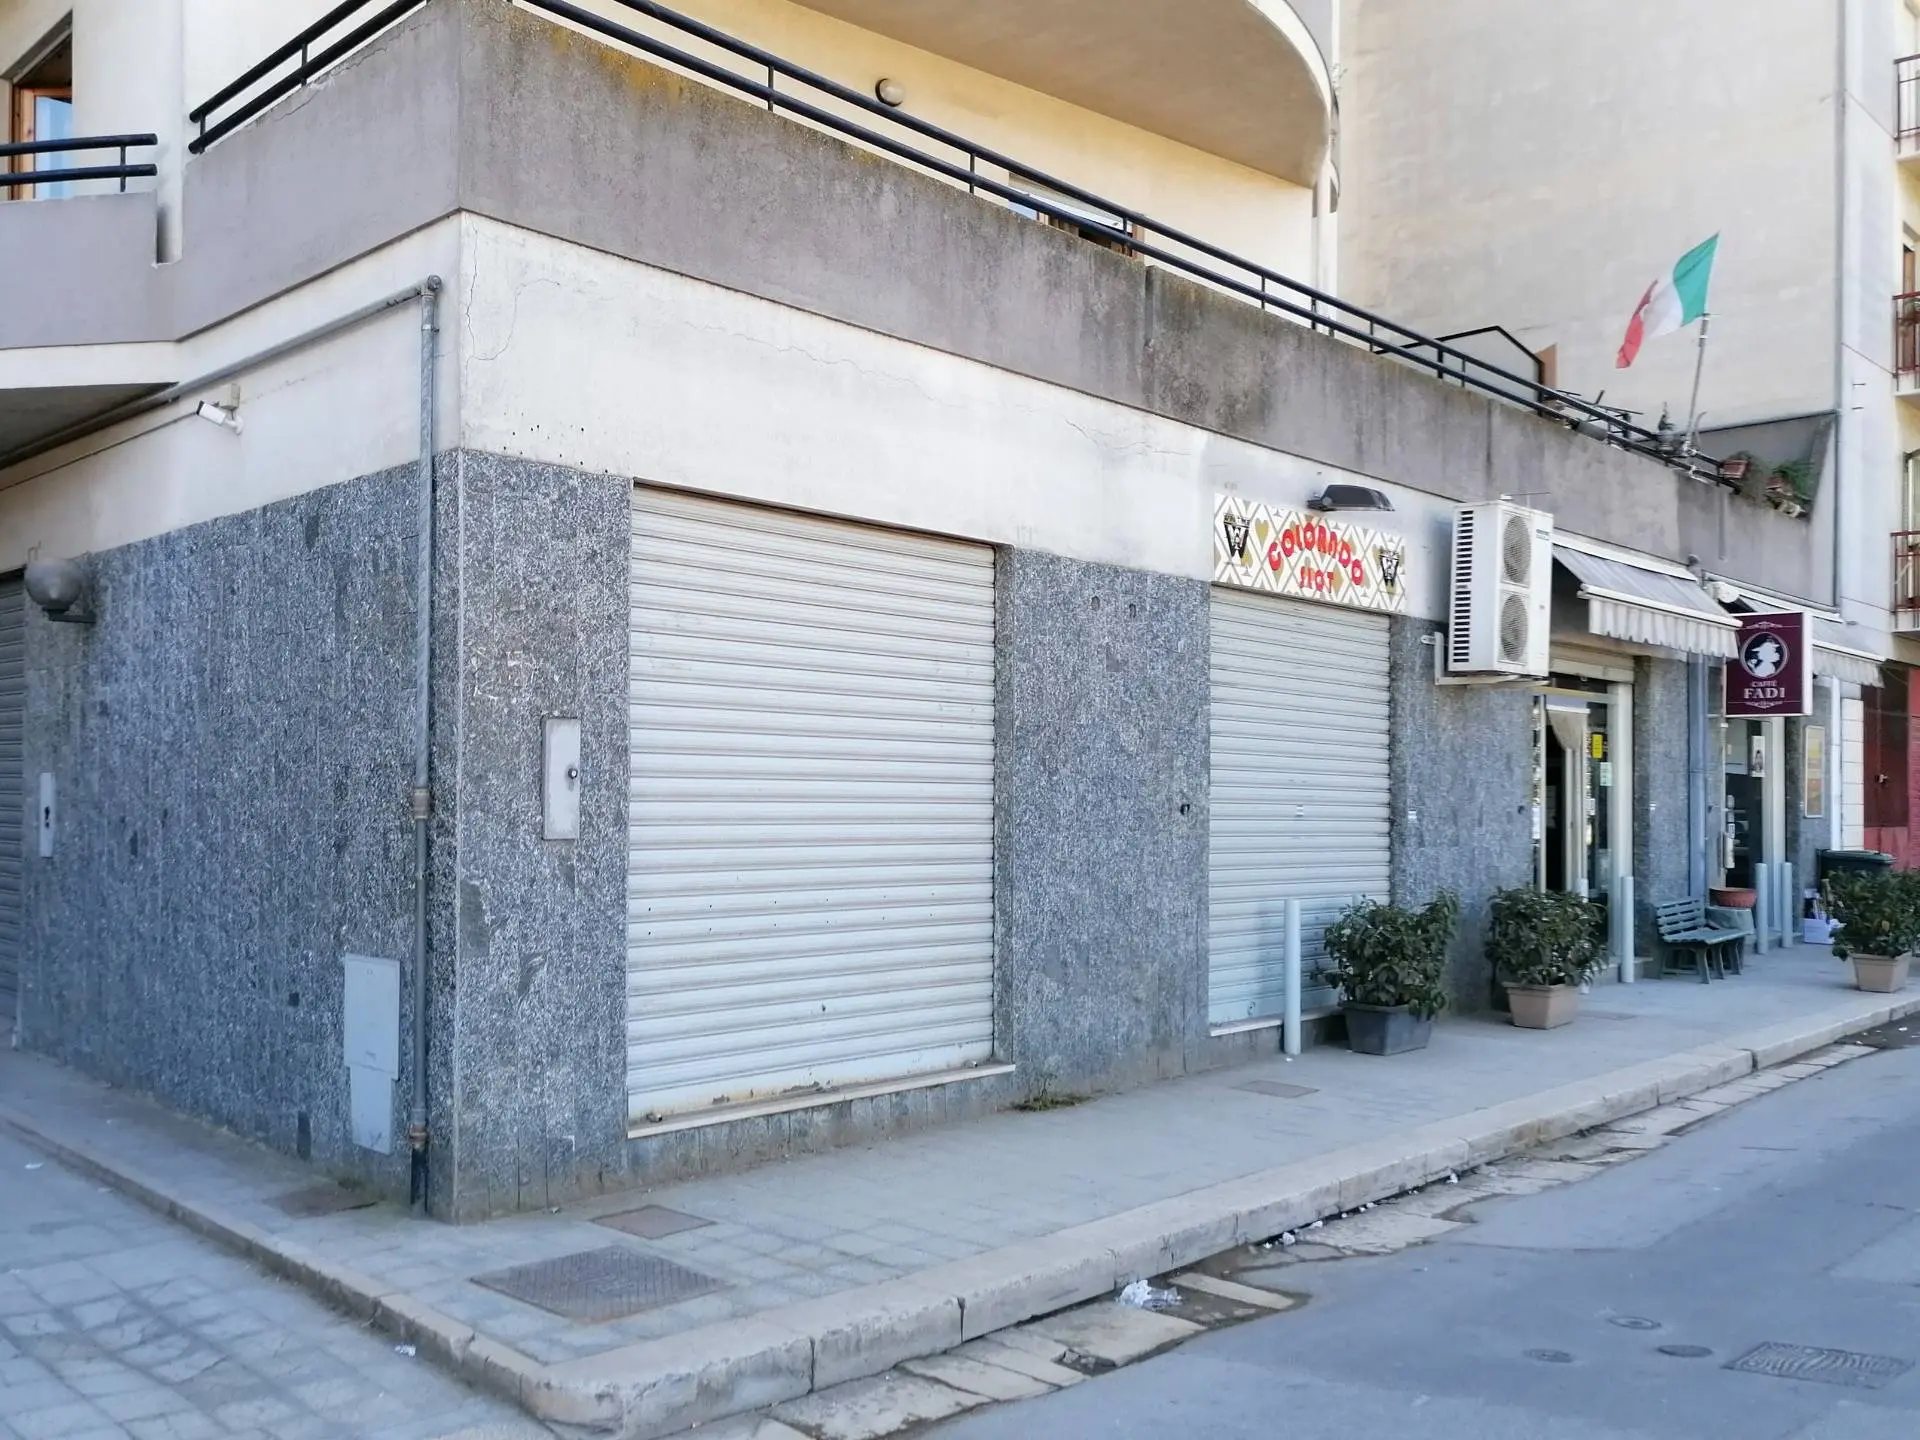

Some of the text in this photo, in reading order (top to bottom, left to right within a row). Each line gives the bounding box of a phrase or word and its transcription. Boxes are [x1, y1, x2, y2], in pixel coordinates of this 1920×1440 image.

[1268, 522, 1363, 586] COLORADO
[1300, 566, 1334, 594] SLOT
[1743, 687, 1786, 699] FADI
